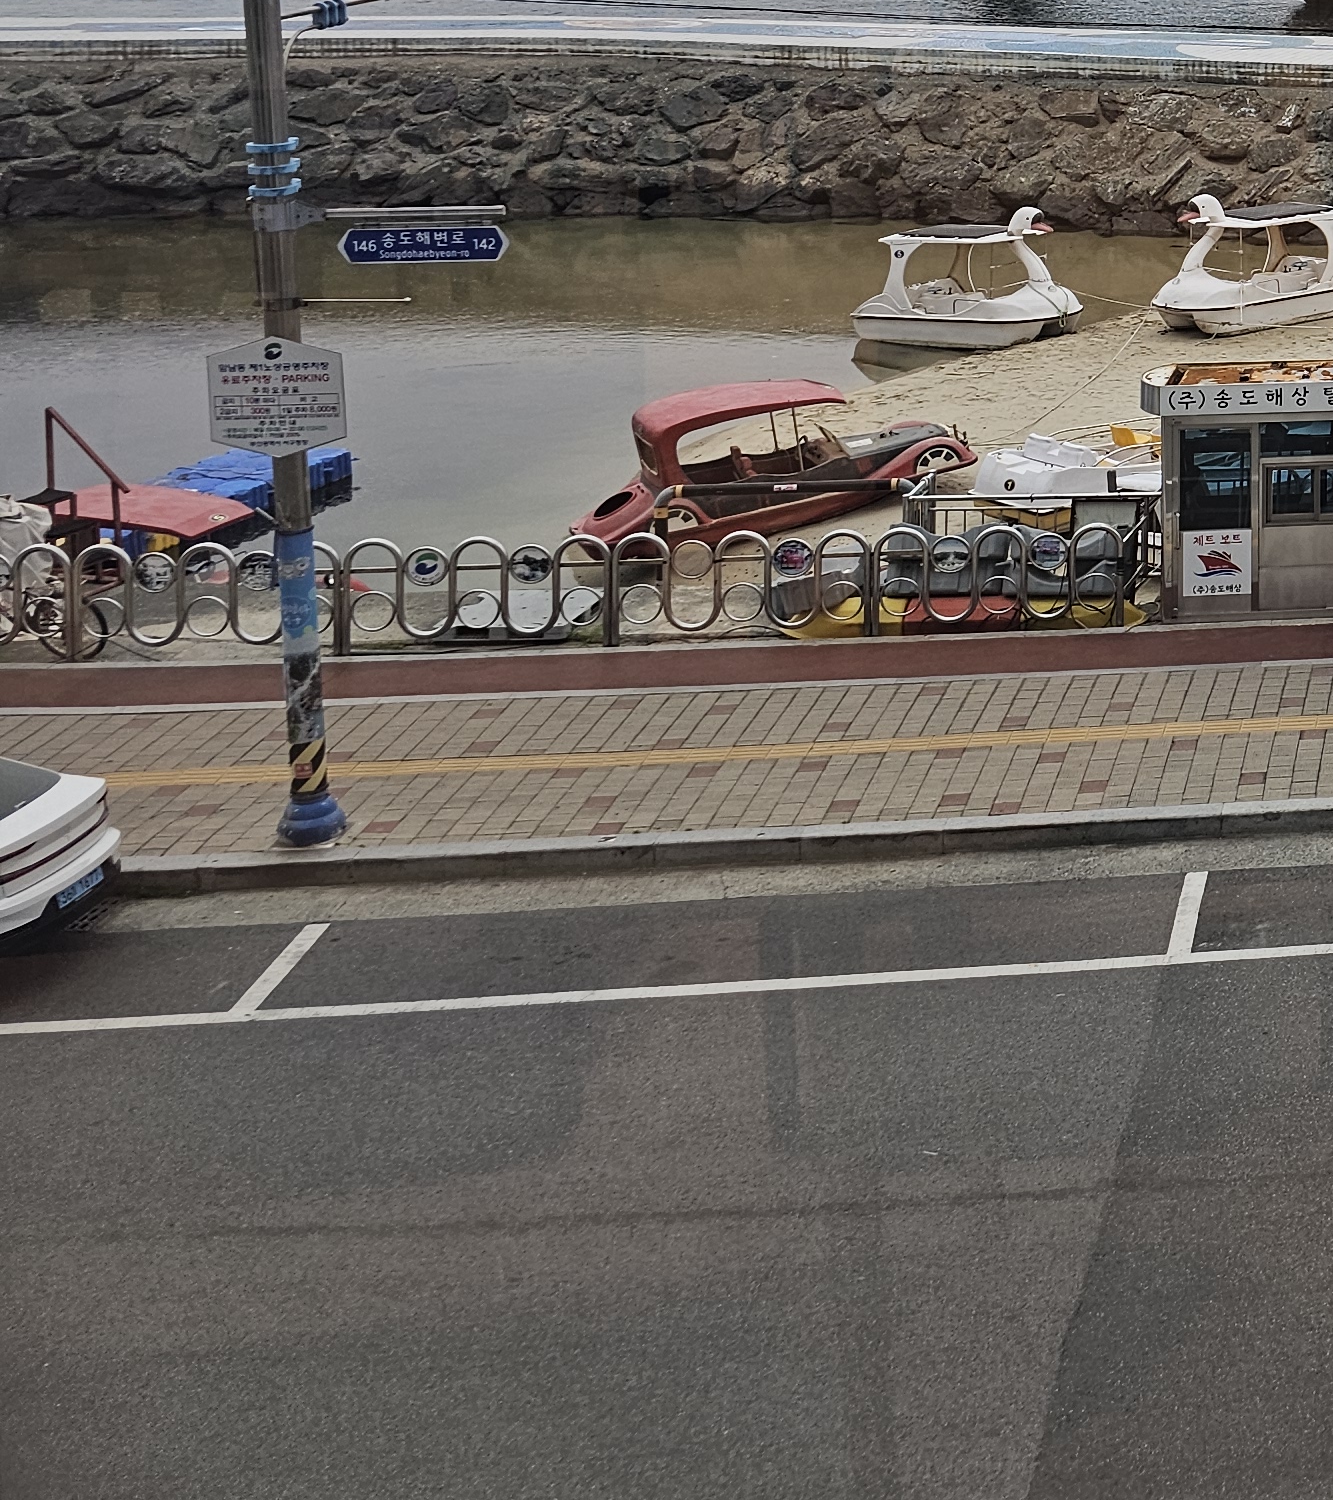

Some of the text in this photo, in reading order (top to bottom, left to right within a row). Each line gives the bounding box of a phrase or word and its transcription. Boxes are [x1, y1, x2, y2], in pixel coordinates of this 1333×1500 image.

[352, 240, 377, 252] 146
[381, 231, 466, 249] 송도해변로
[472, 237, 496, 250] 142
[281, 373, 330, 383] PARKING
[1193, 534, 1243, 546] 제트 보트
